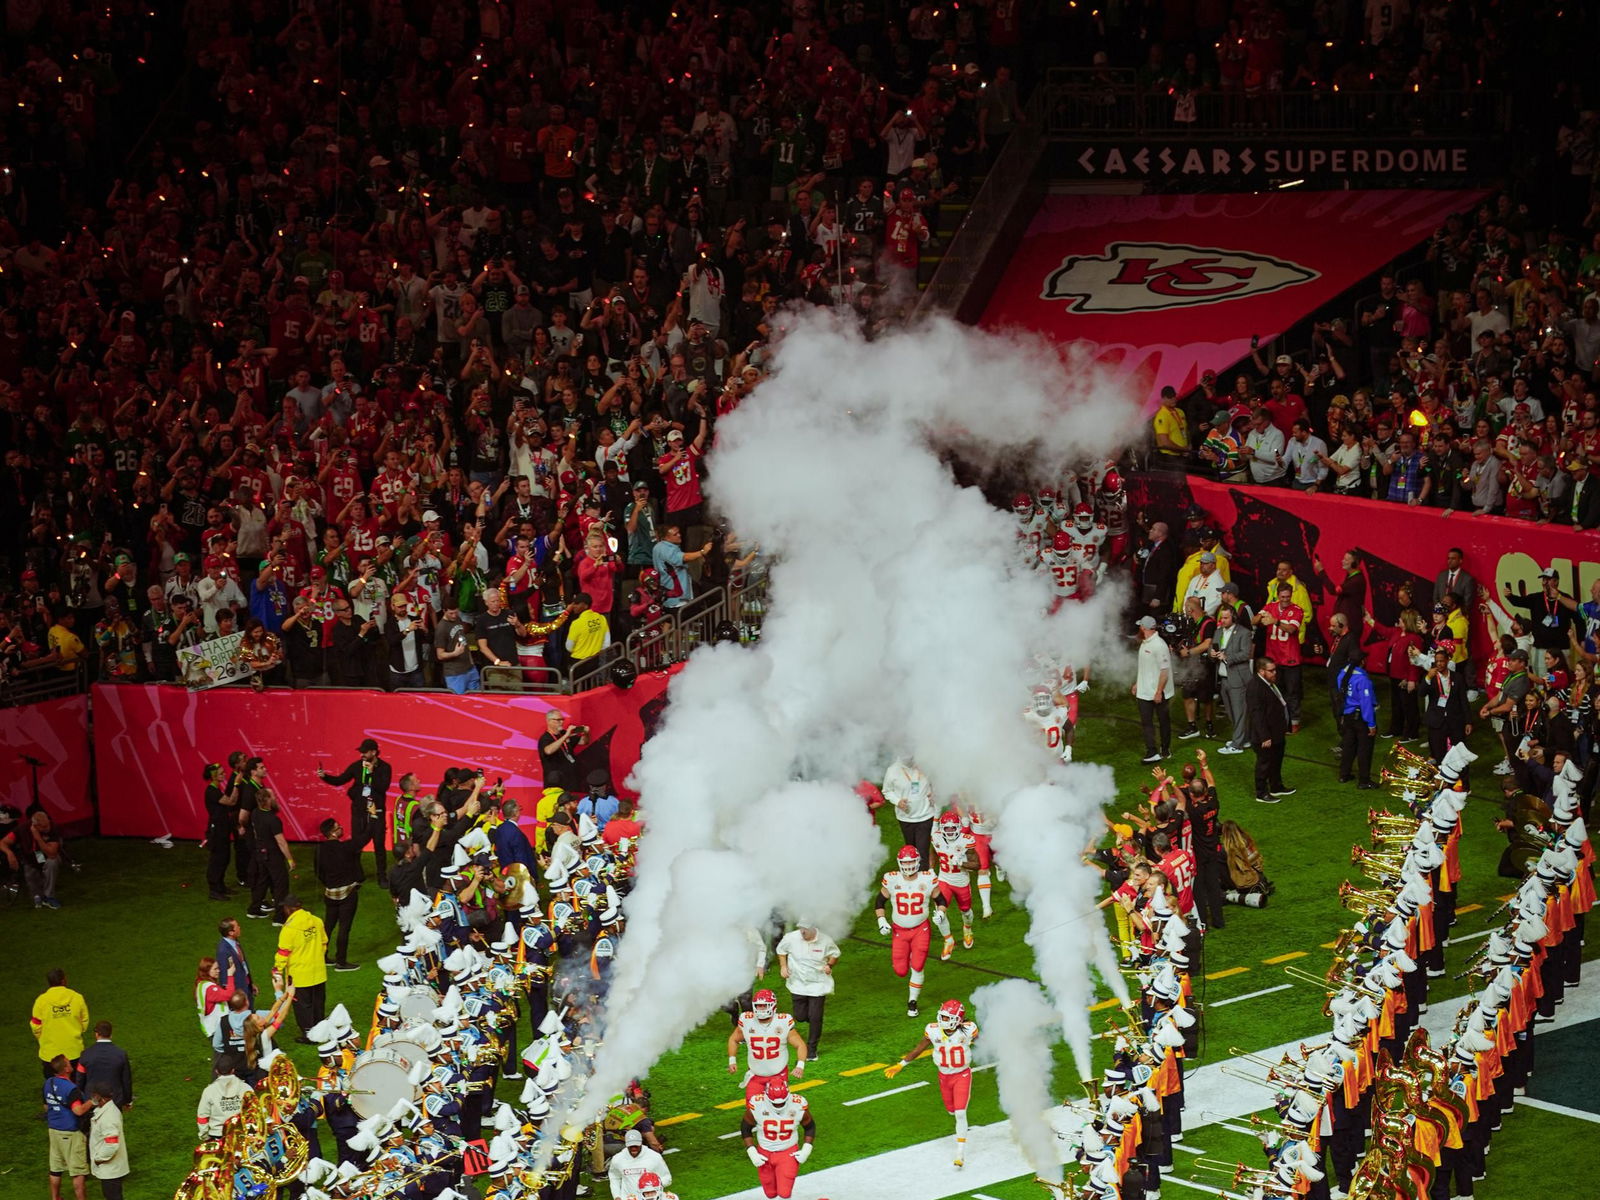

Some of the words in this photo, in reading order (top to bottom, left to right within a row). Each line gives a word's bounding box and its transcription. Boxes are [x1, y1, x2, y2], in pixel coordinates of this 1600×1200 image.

[1381, 5, 1391, 26] 9
[779, 142, 794, 163] 11
[1077, 147, 1256, 174] CAESARS
[1264, 148, 1468, 173] SUPERDOME
[855, 211, 875, 231] 27
[1107, 257, 1258, 297] KC
[486, 291, 511, 312] 26
[284, 320, 300, 339] 15
[359, 323, 378, 343] 87
[114, 450, 138, 471] 26
[333, 476, 354, 497] 29
[182, 501, 206, 527] 26
[353, 530, 374, 552] 15
[1173, 861, 1193, 892] 15
[895, 893, 924, 915] 62
[52, 1005, 71, 1014] CSC
[750, 1036, 781, 1060] 52
[938, 1045, 965, 1068] 10
[763, 1119, 794, 1141] 65
